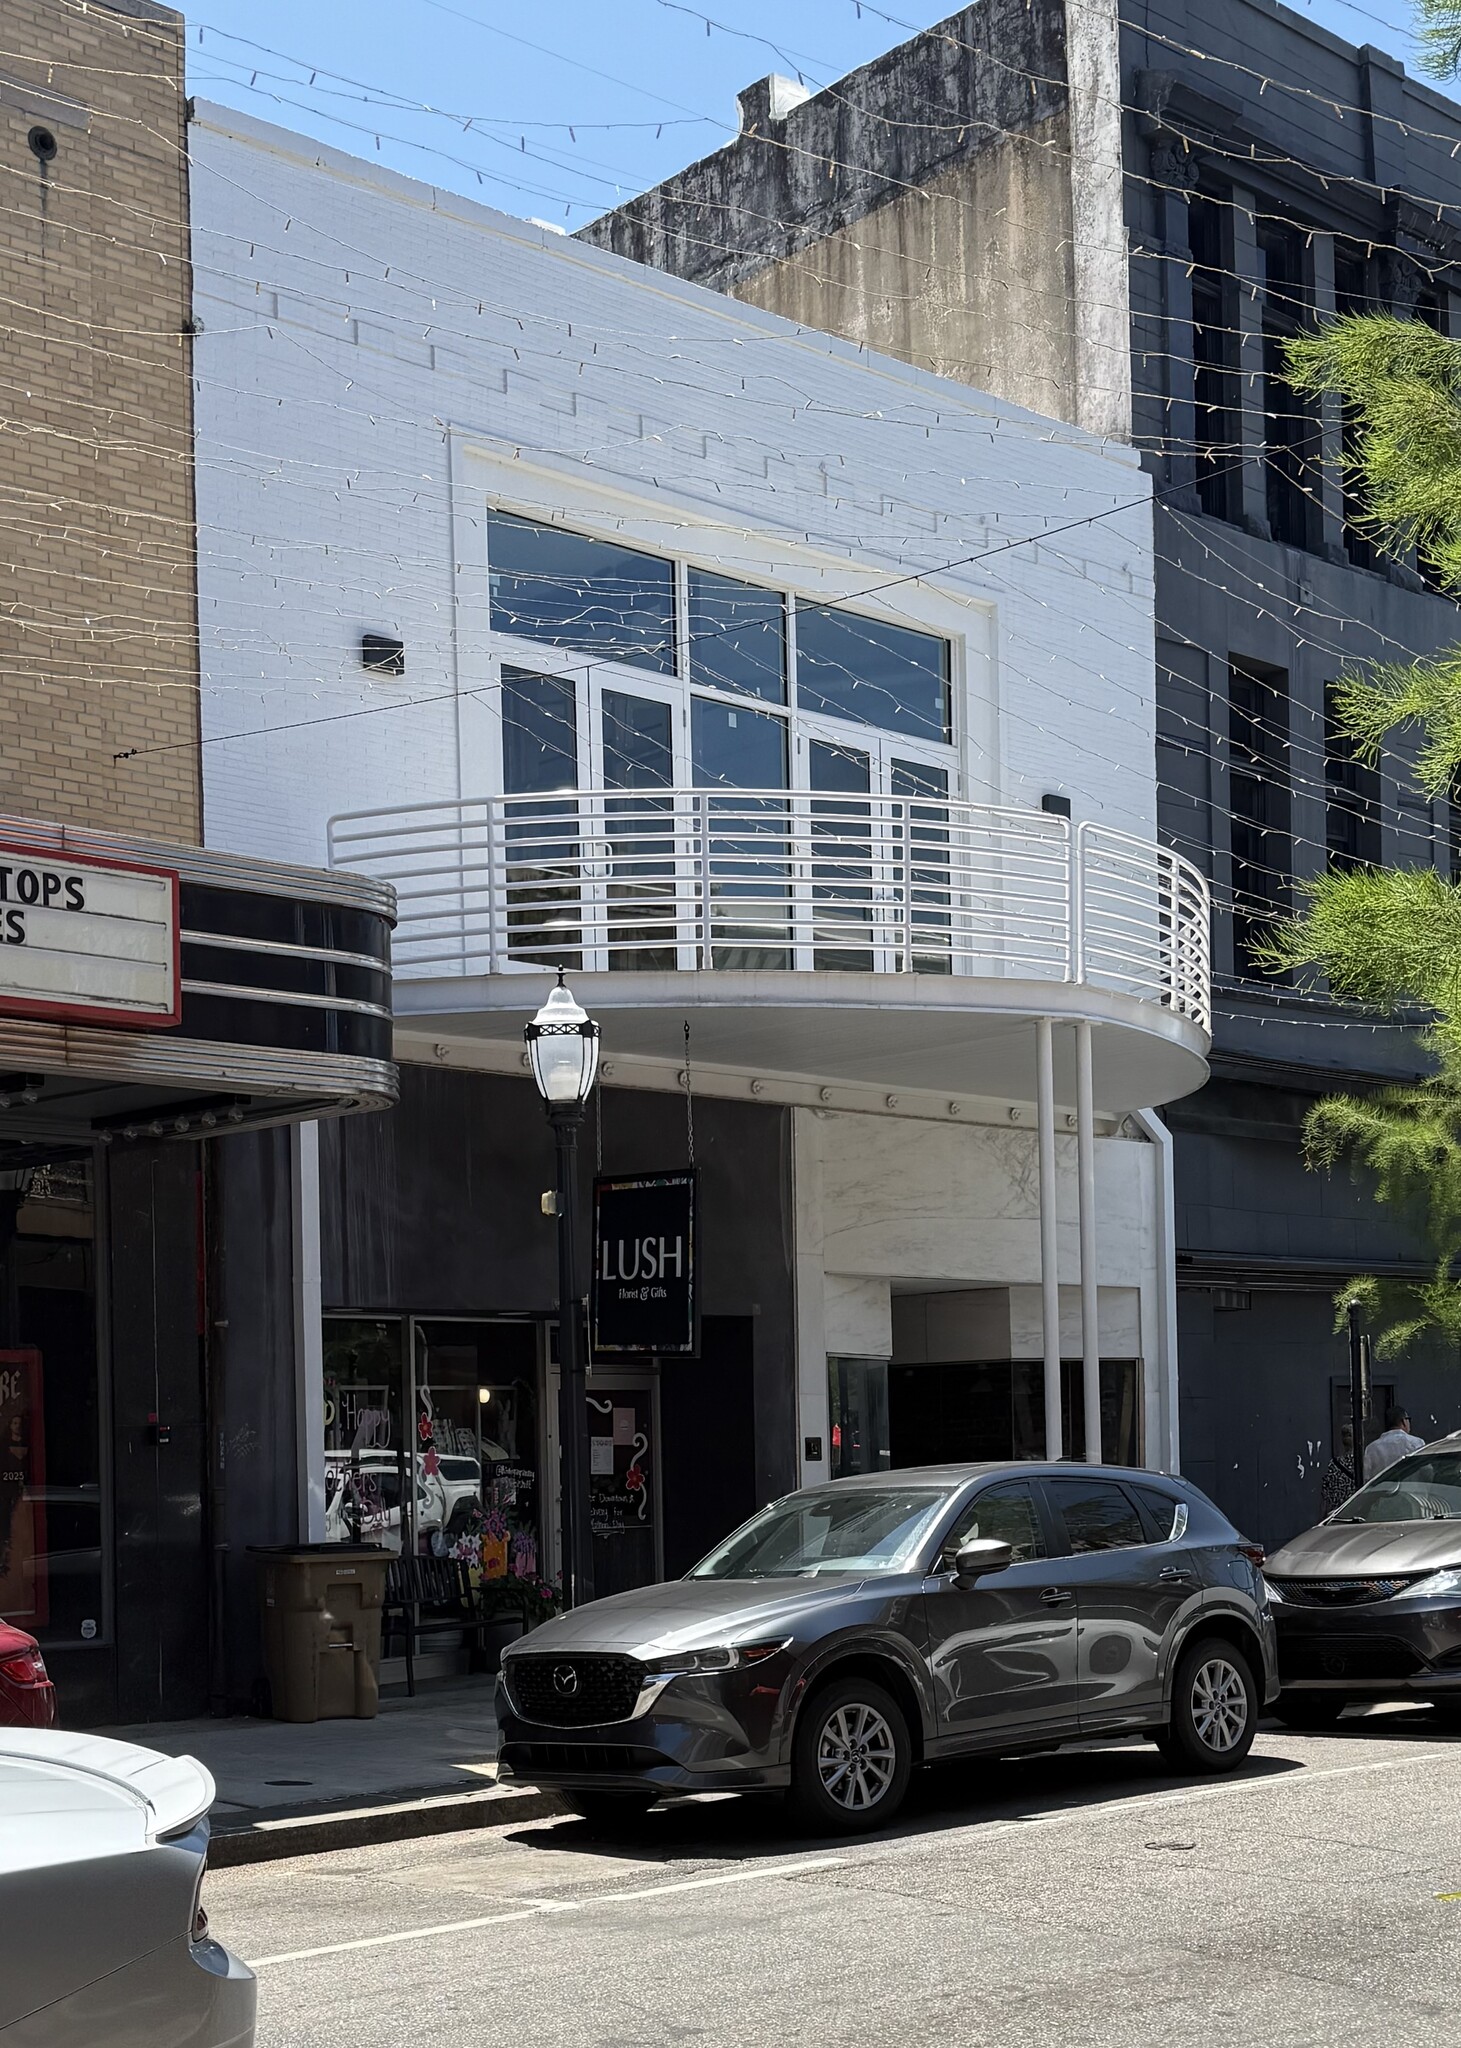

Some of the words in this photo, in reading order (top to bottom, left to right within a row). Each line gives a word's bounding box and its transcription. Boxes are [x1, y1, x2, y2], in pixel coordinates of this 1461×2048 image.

[602, 1236, 682, 1280] LUSH
[640, 1286, 650, 1301] &
[650, 1286, 667, 1299] Gifts
[3, 1471, 25, 1481] 2025
